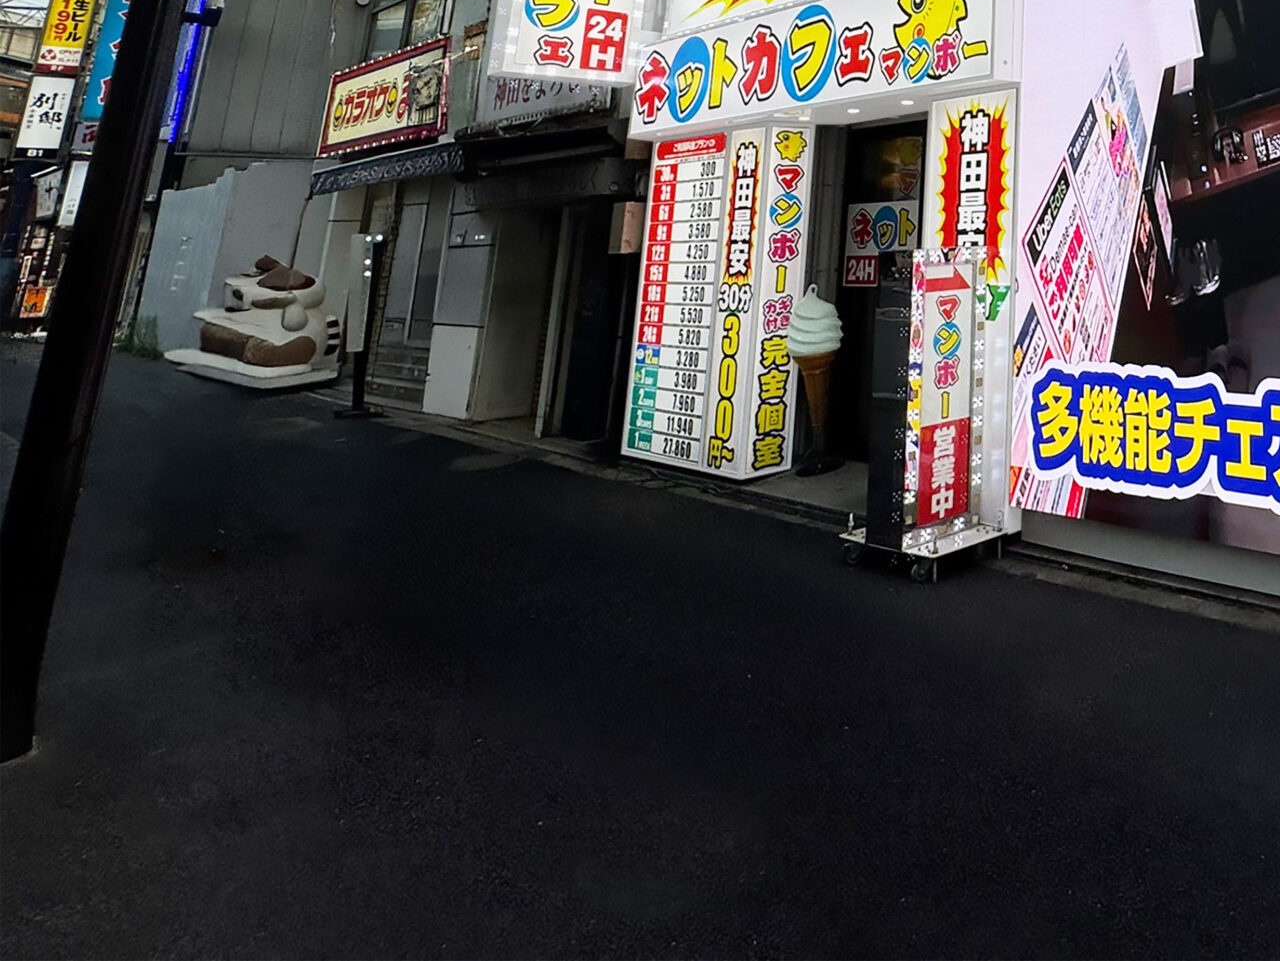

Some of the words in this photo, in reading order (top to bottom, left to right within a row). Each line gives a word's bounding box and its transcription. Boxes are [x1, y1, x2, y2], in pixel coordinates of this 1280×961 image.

[64, 0, 91, 43] 生ビール
[729, 141, 758, 277] 神田最安
[767, 163, 805, 294] マンボー
[851, 208, 916, 249] ネット
[847, 258, 876, 282] 24H
[751, 334, 791, 472] 完全個室
[934, 294, 961, 420] マンボー
[930, 425, 956, 519] 営業中
